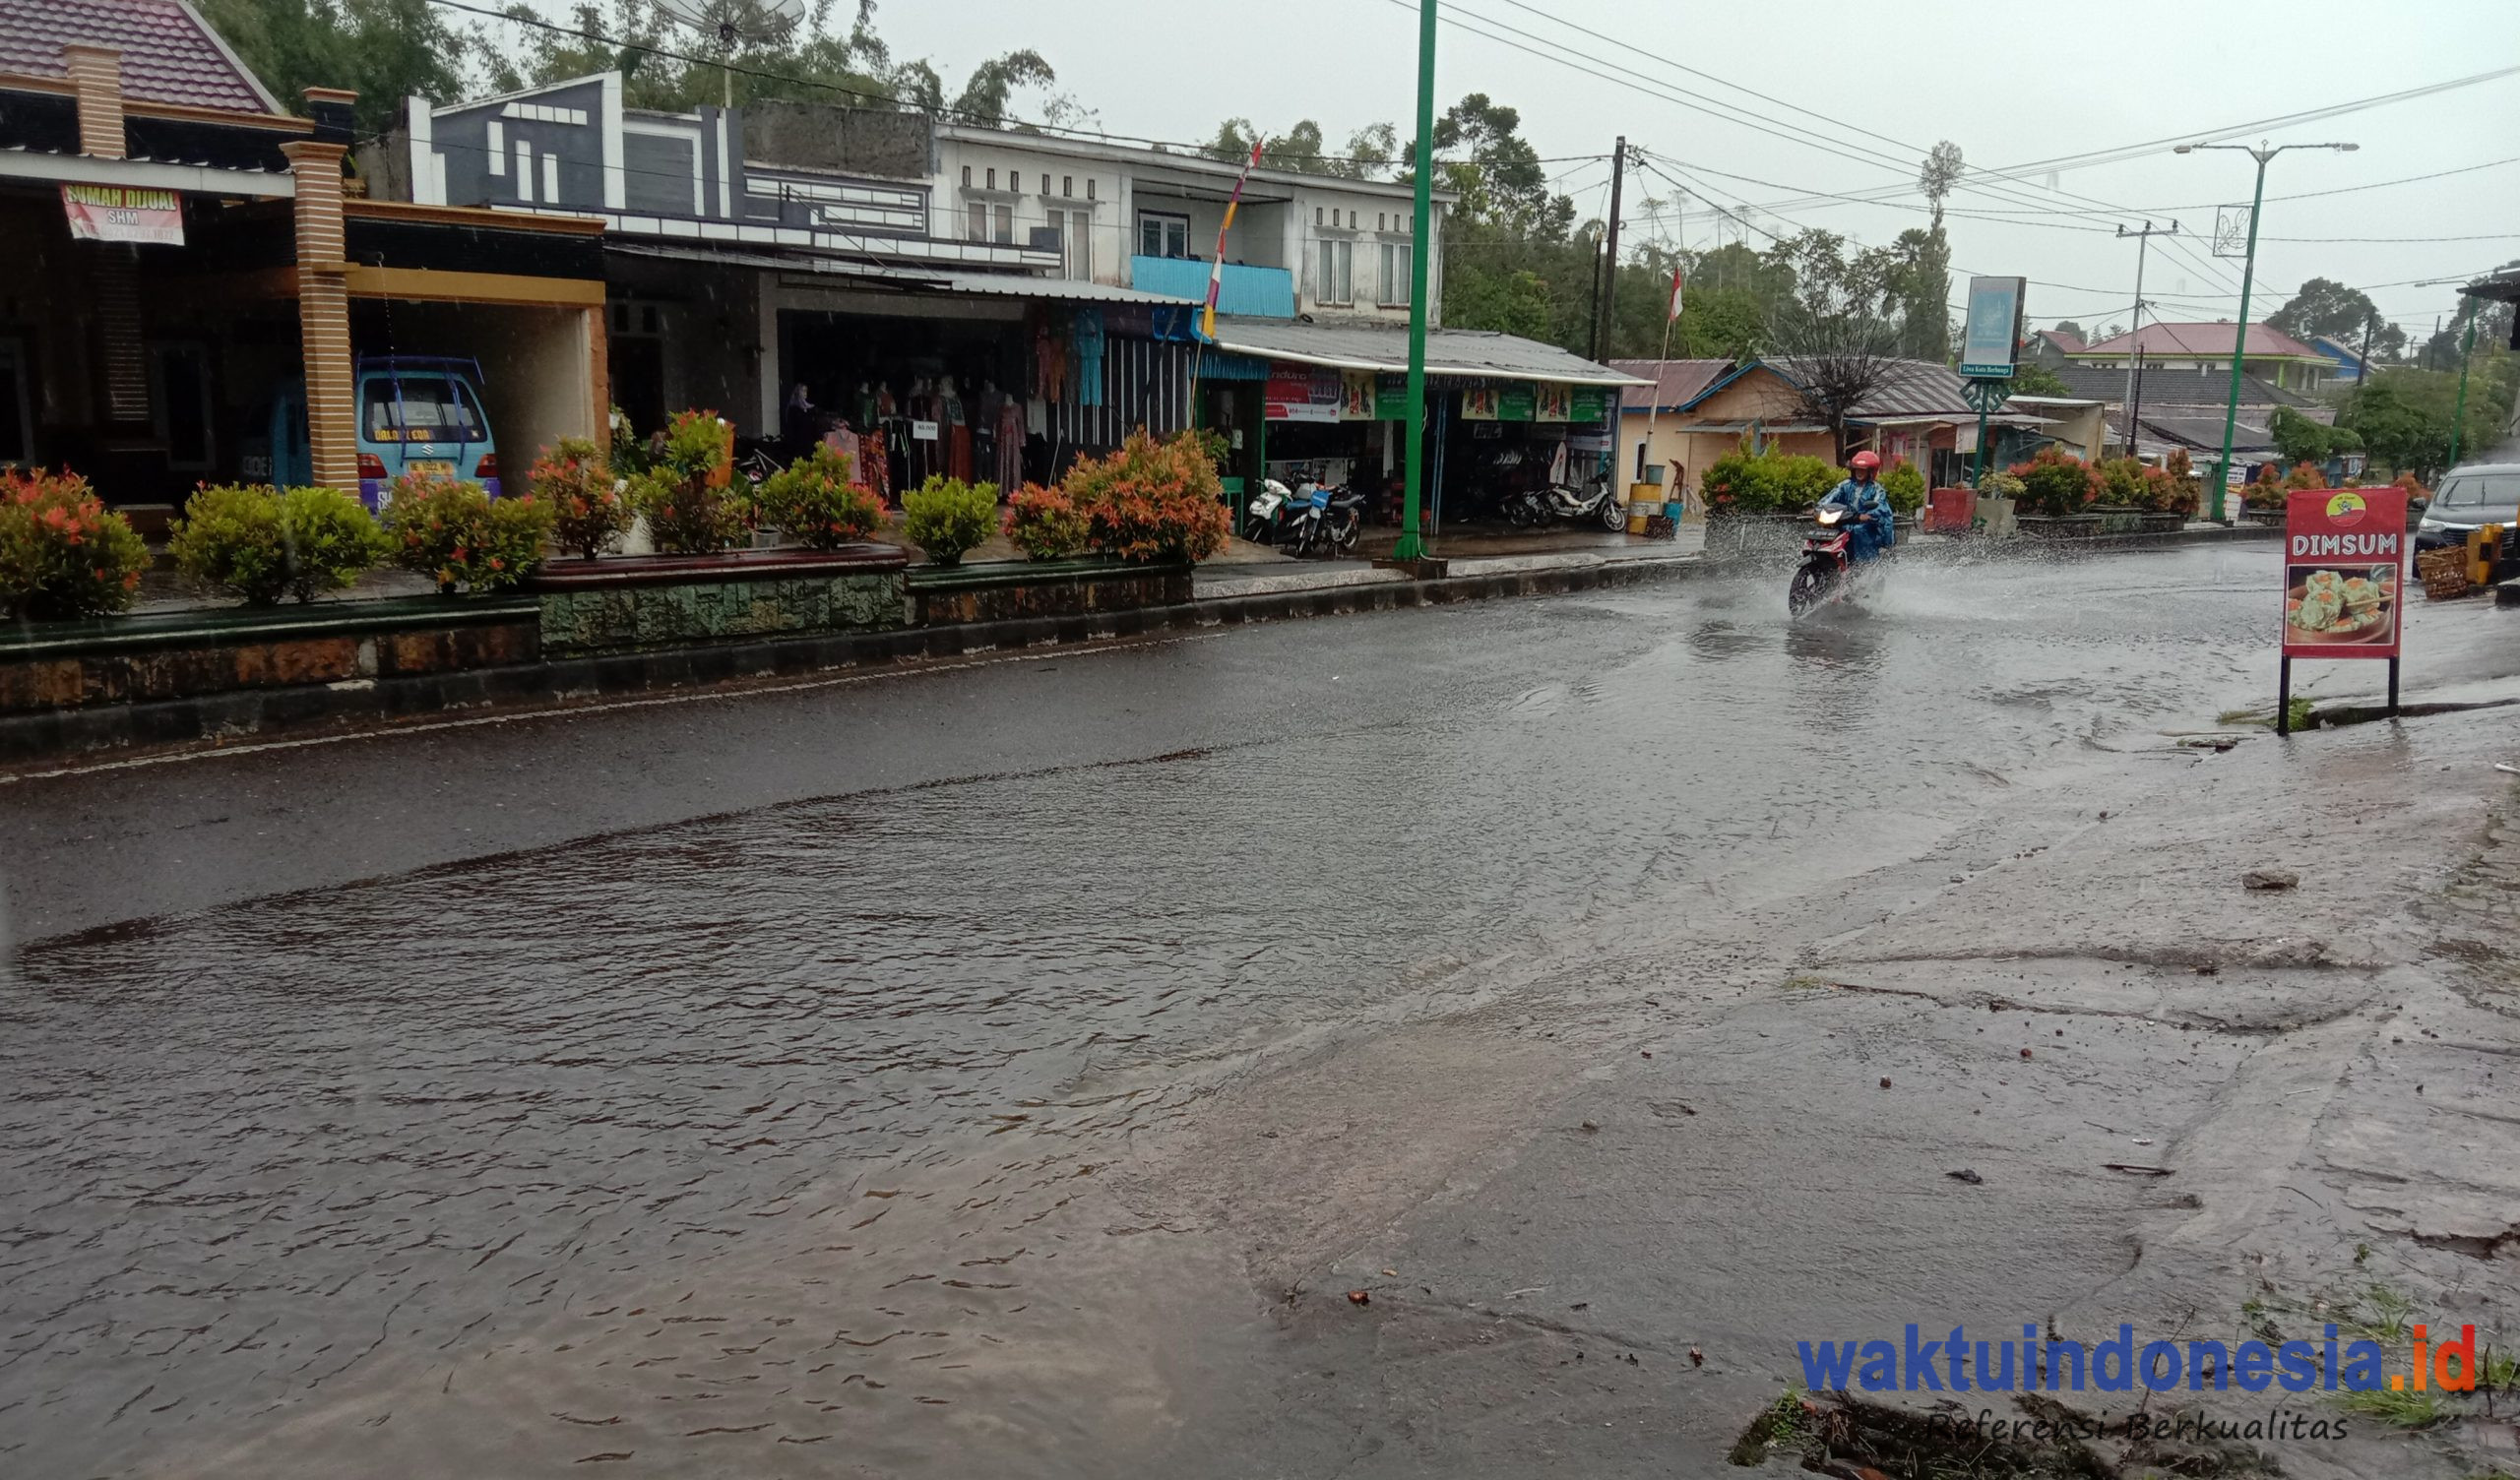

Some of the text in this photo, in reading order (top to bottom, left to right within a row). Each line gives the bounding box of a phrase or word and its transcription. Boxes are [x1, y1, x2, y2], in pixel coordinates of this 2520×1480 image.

[125, 188, 177, 211] DIJUAL
[107, 210, 139, 225] SHM
[1270, 369, 1307, 380] nduro
[2292, 532, 2398, 557] DIMSUM
